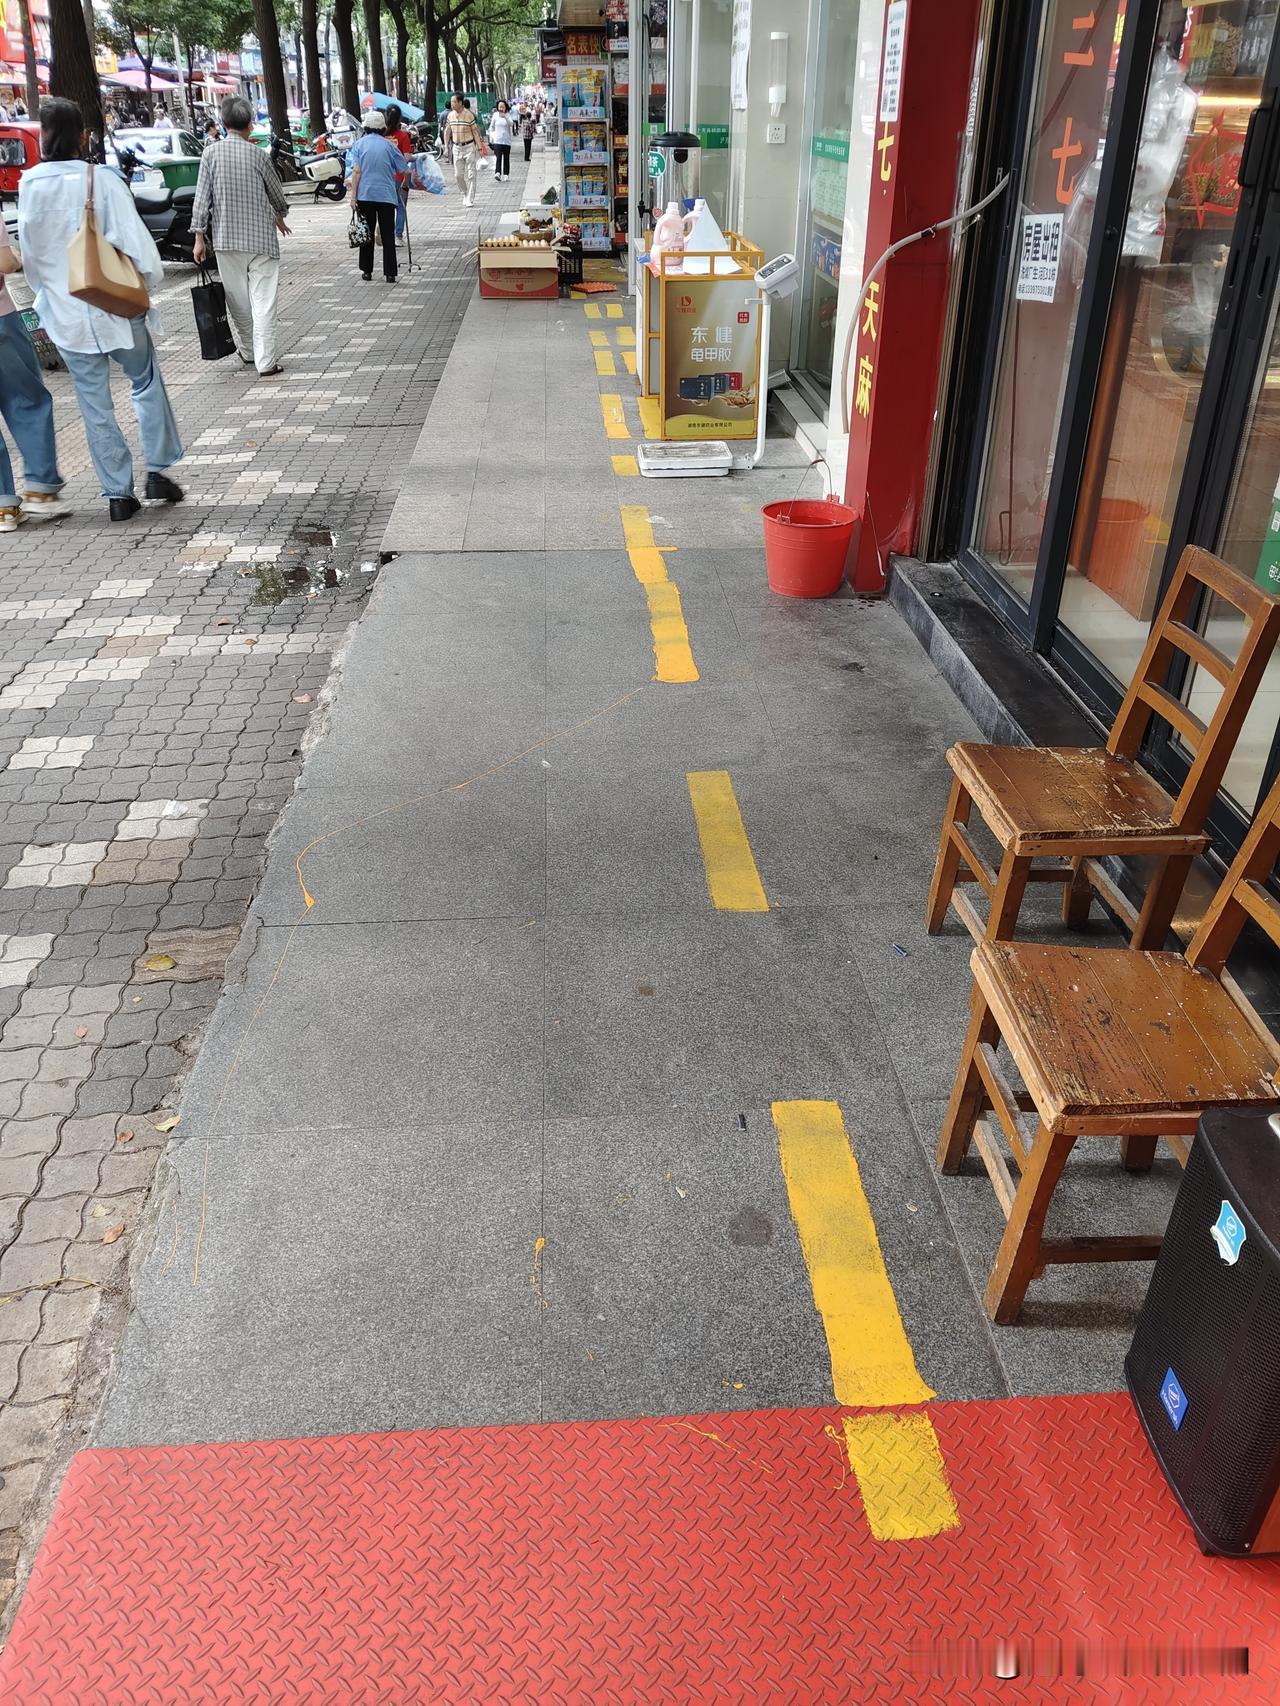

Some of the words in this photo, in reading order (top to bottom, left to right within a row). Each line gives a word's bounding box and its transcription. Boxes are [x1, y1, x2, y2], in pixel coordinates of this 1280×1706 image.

[1022, 222, 1061, 263] 房屋出租
[691, 326, 733, 344] 东健
[691, 347, 732, 362] 龟甲胶
